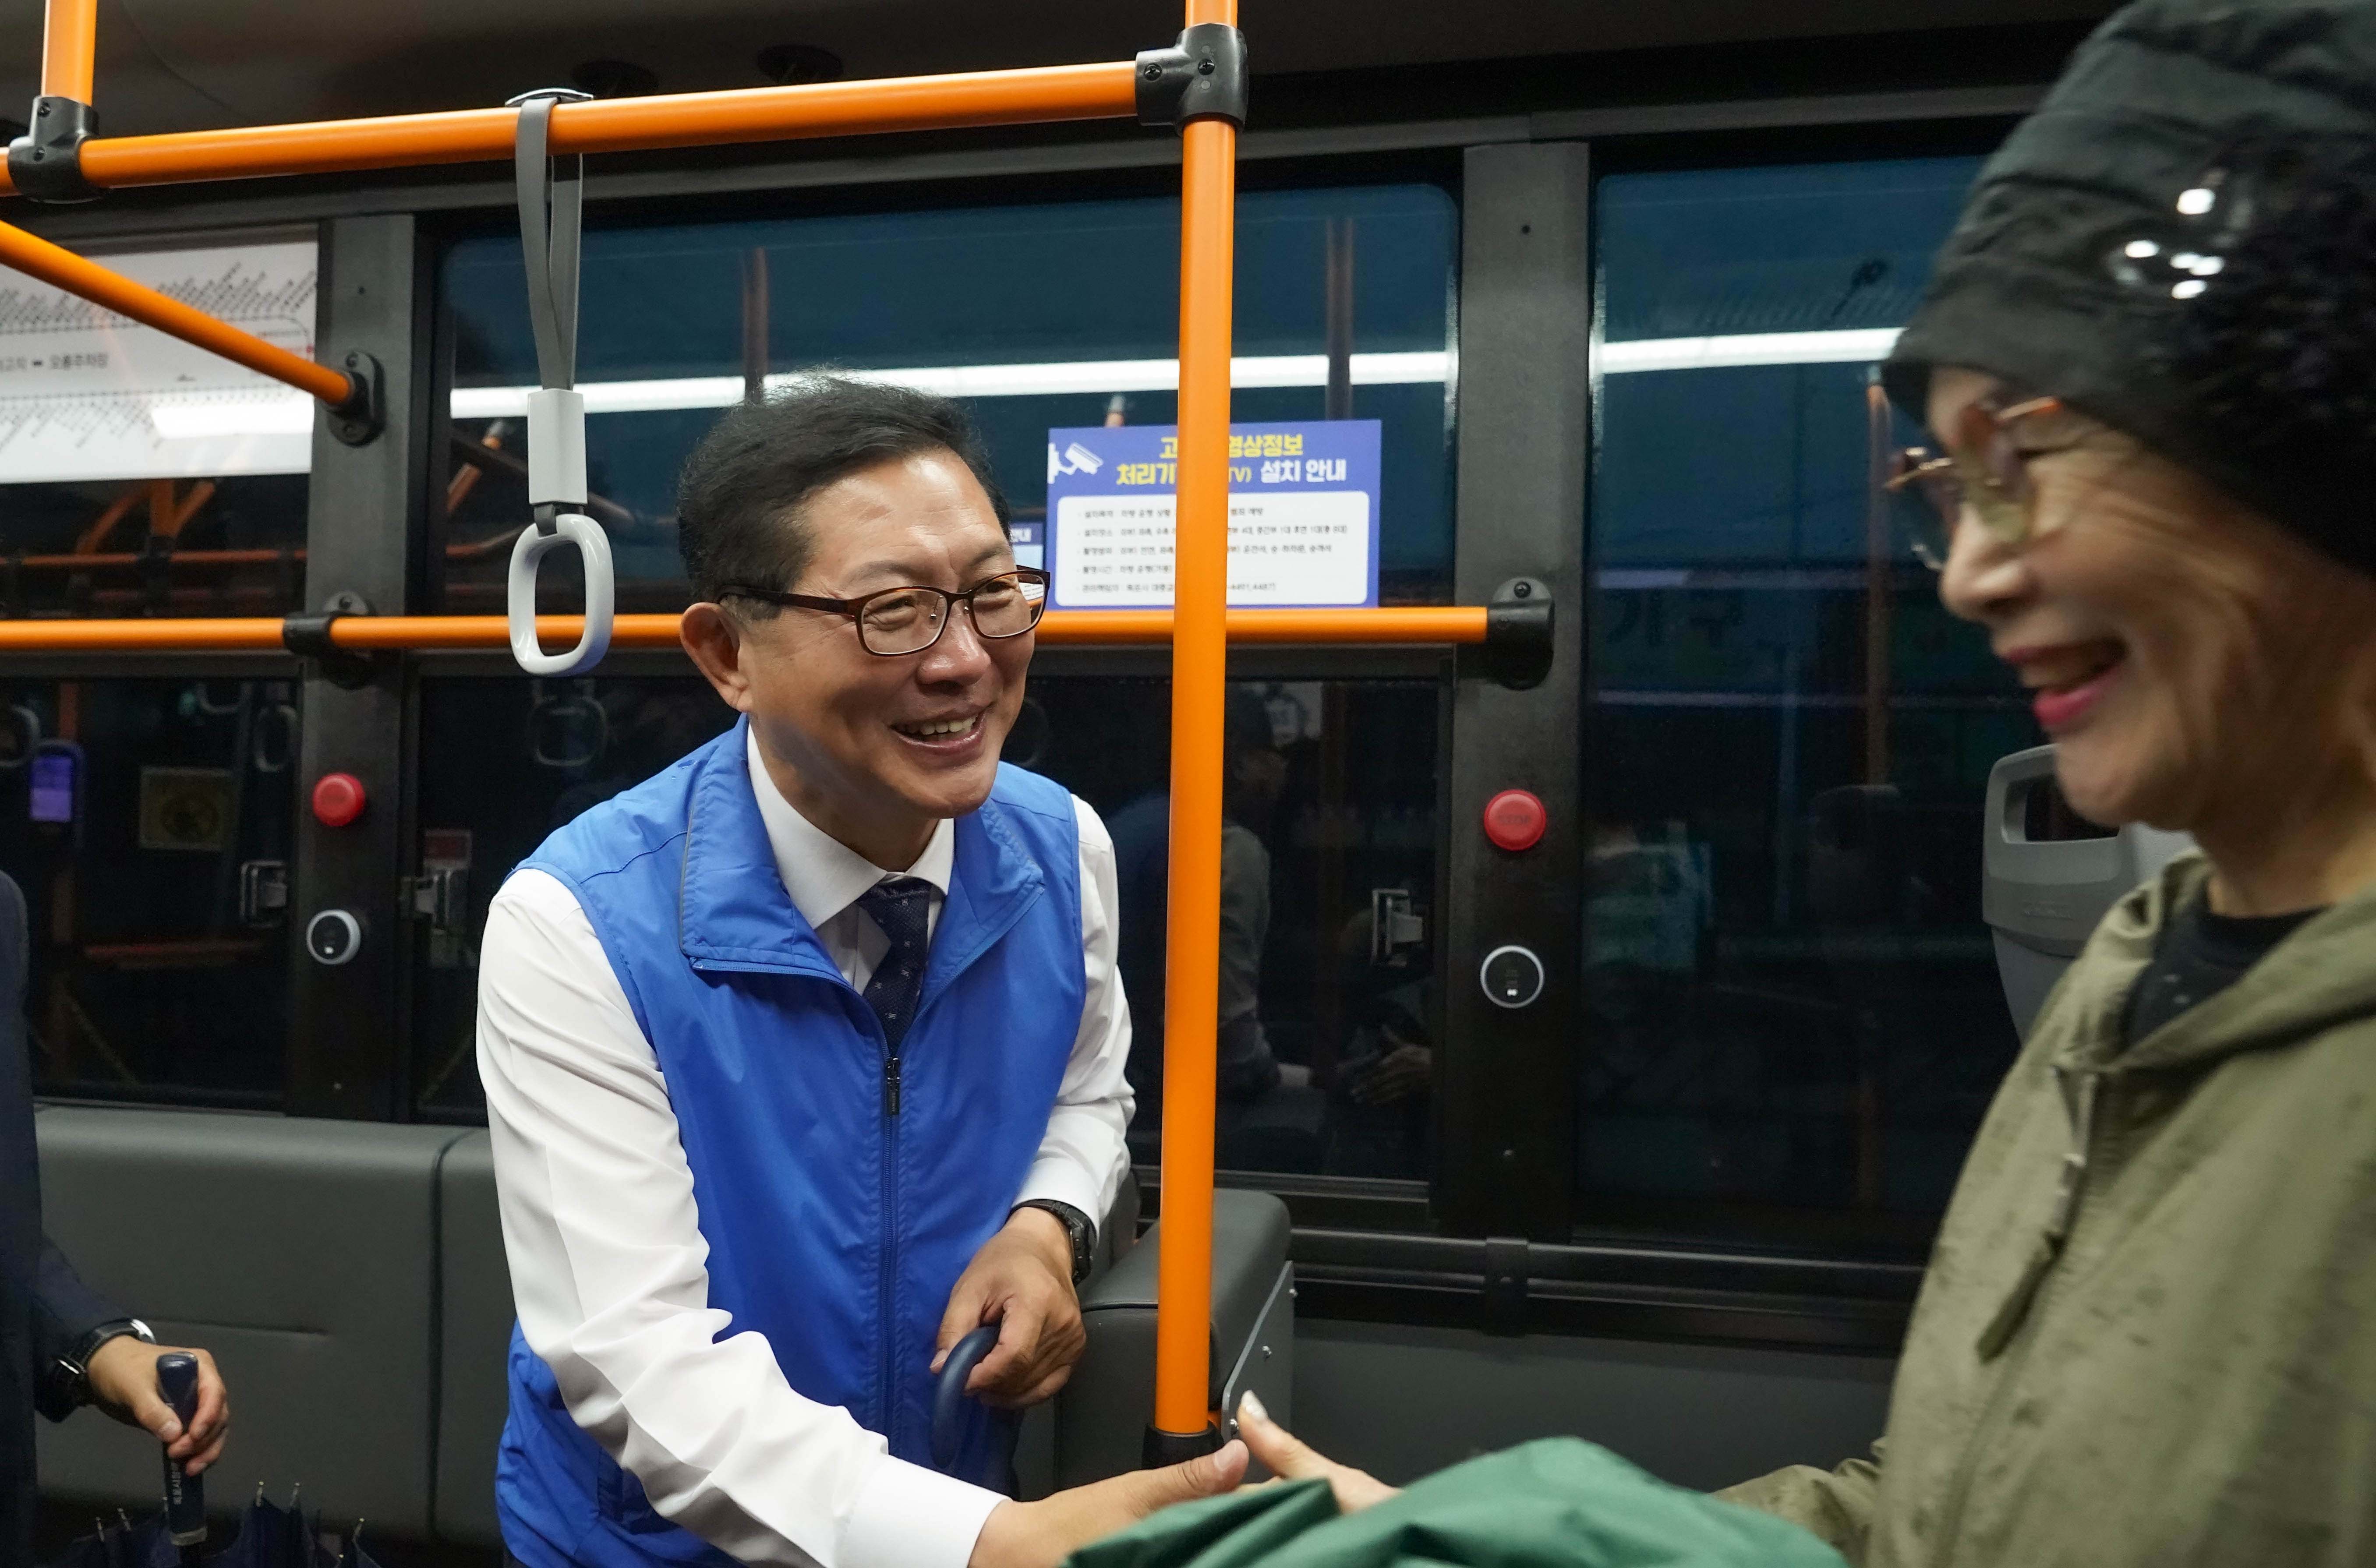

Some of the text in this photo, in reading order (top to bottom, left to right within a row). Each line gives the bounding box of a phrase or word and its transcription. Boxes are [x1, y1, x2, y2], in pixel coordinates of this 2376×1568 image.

[1228, 434, 1304, 458] 영상정보
[1261, 459, 1301, 484] 설치
[1306, 459, 1346, 482] 안내
